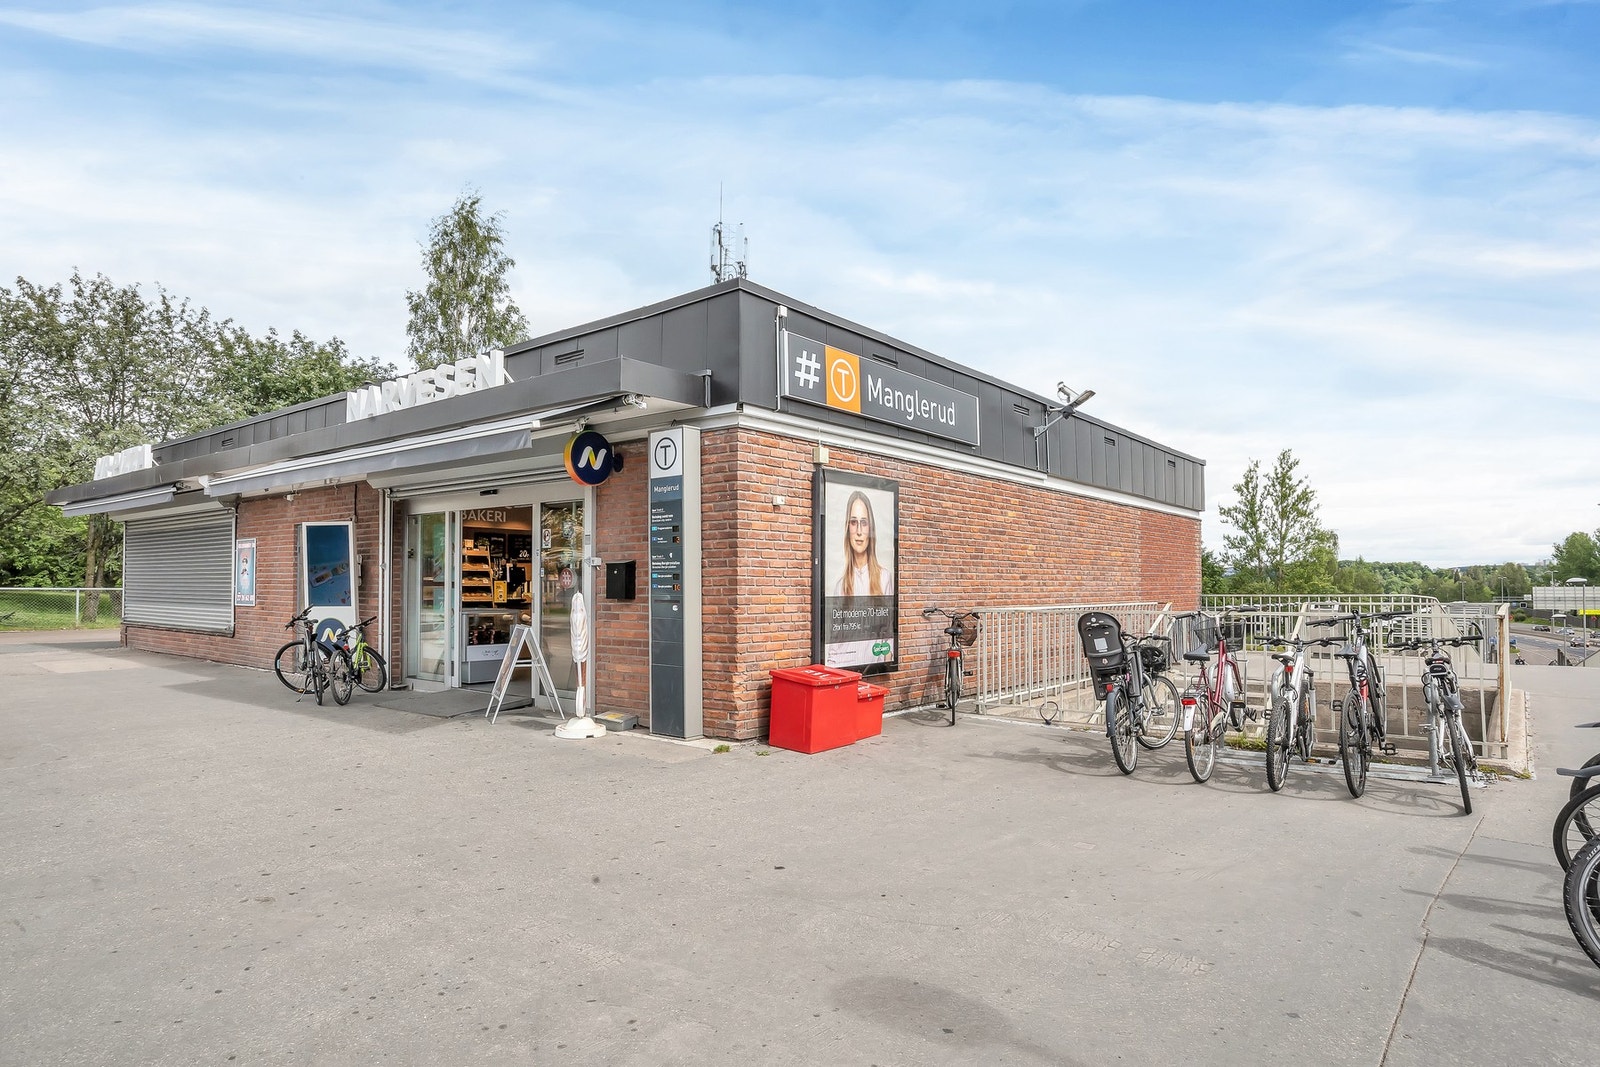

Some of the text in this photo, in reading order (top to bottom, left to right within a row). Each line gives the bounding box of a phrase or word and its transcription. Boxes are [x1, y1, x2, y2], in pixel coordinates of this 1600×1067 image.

[346, 350, 504, 423] NARVESEN
[867, 374, 956, 426] Manglerud
[653, 484, 680, 494] Manglerud
[462, 509, 507, 522] BAKERI
[832, 609, 843, 619] Det
[867, 607, 889, 617] 70-tallet
